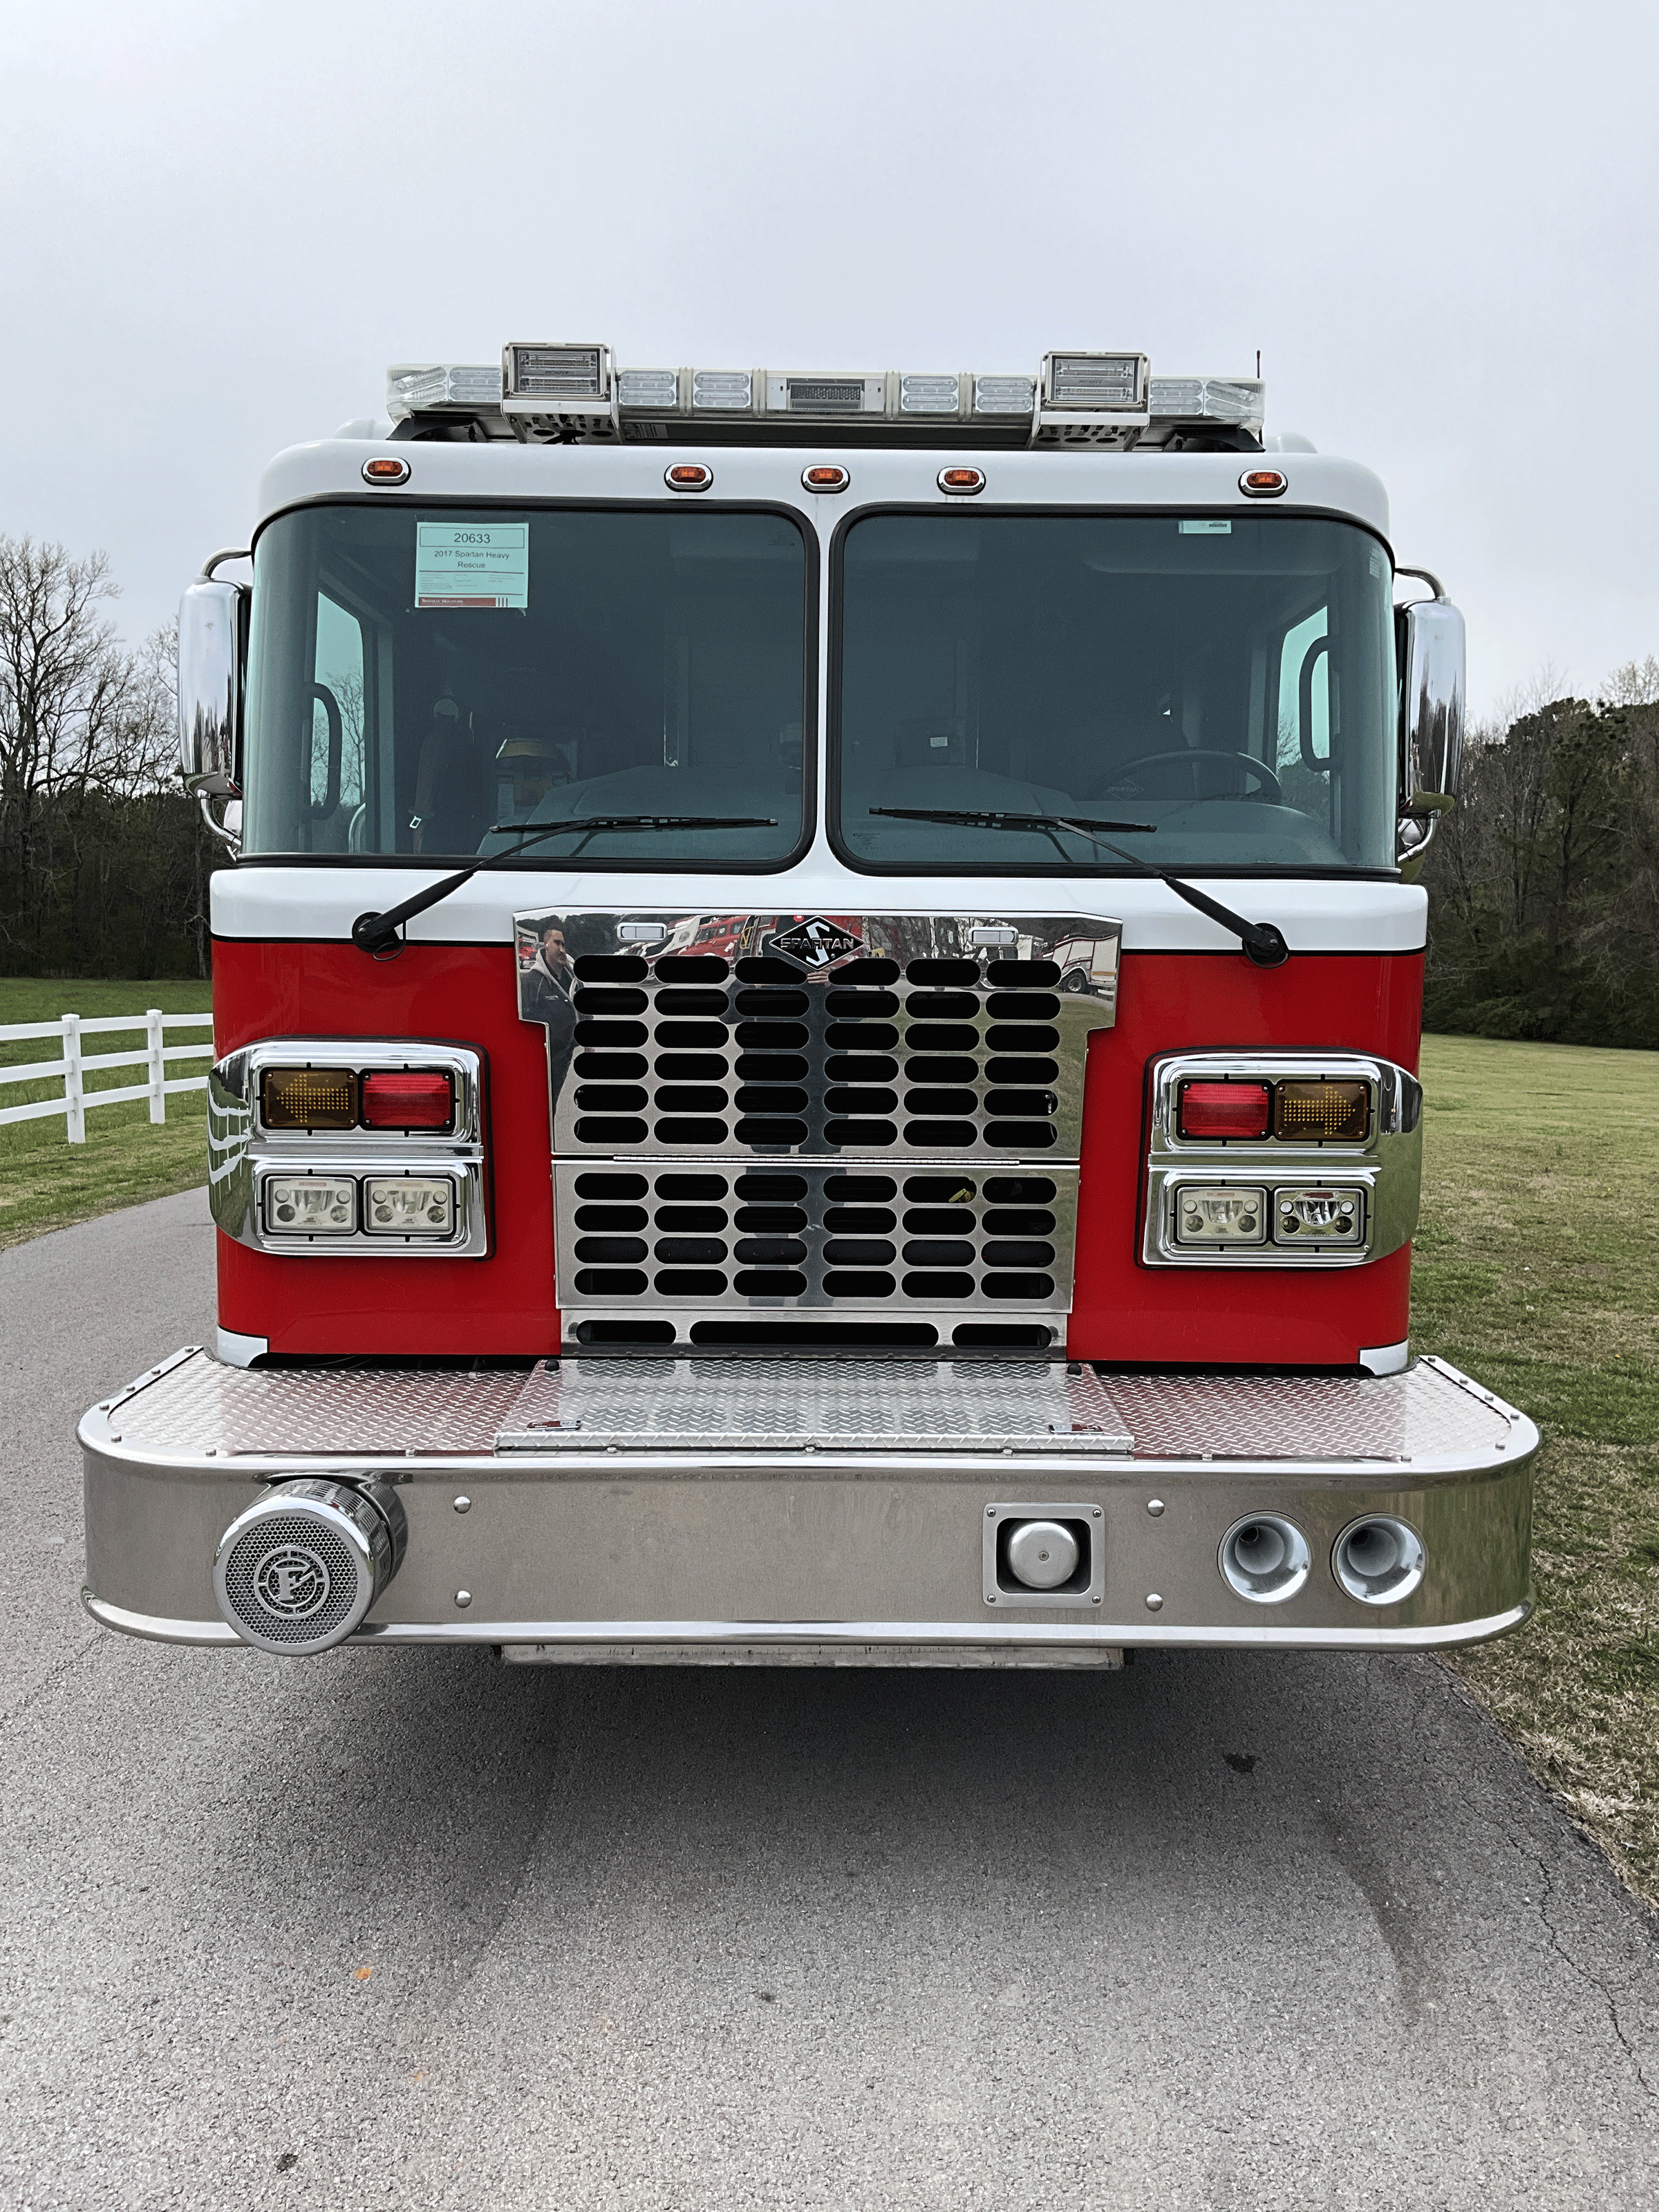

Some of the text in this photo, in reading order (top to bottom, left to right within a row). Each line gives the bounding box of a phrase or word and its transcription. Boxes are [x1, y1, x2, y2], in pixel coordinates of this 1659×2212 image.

[454, 533, 491, 544] 20633
[455, 550, 484, 559] Spartan
[486, 552, 509, 560] Heavy
[780, 938, 854, 949] SPARTAN
